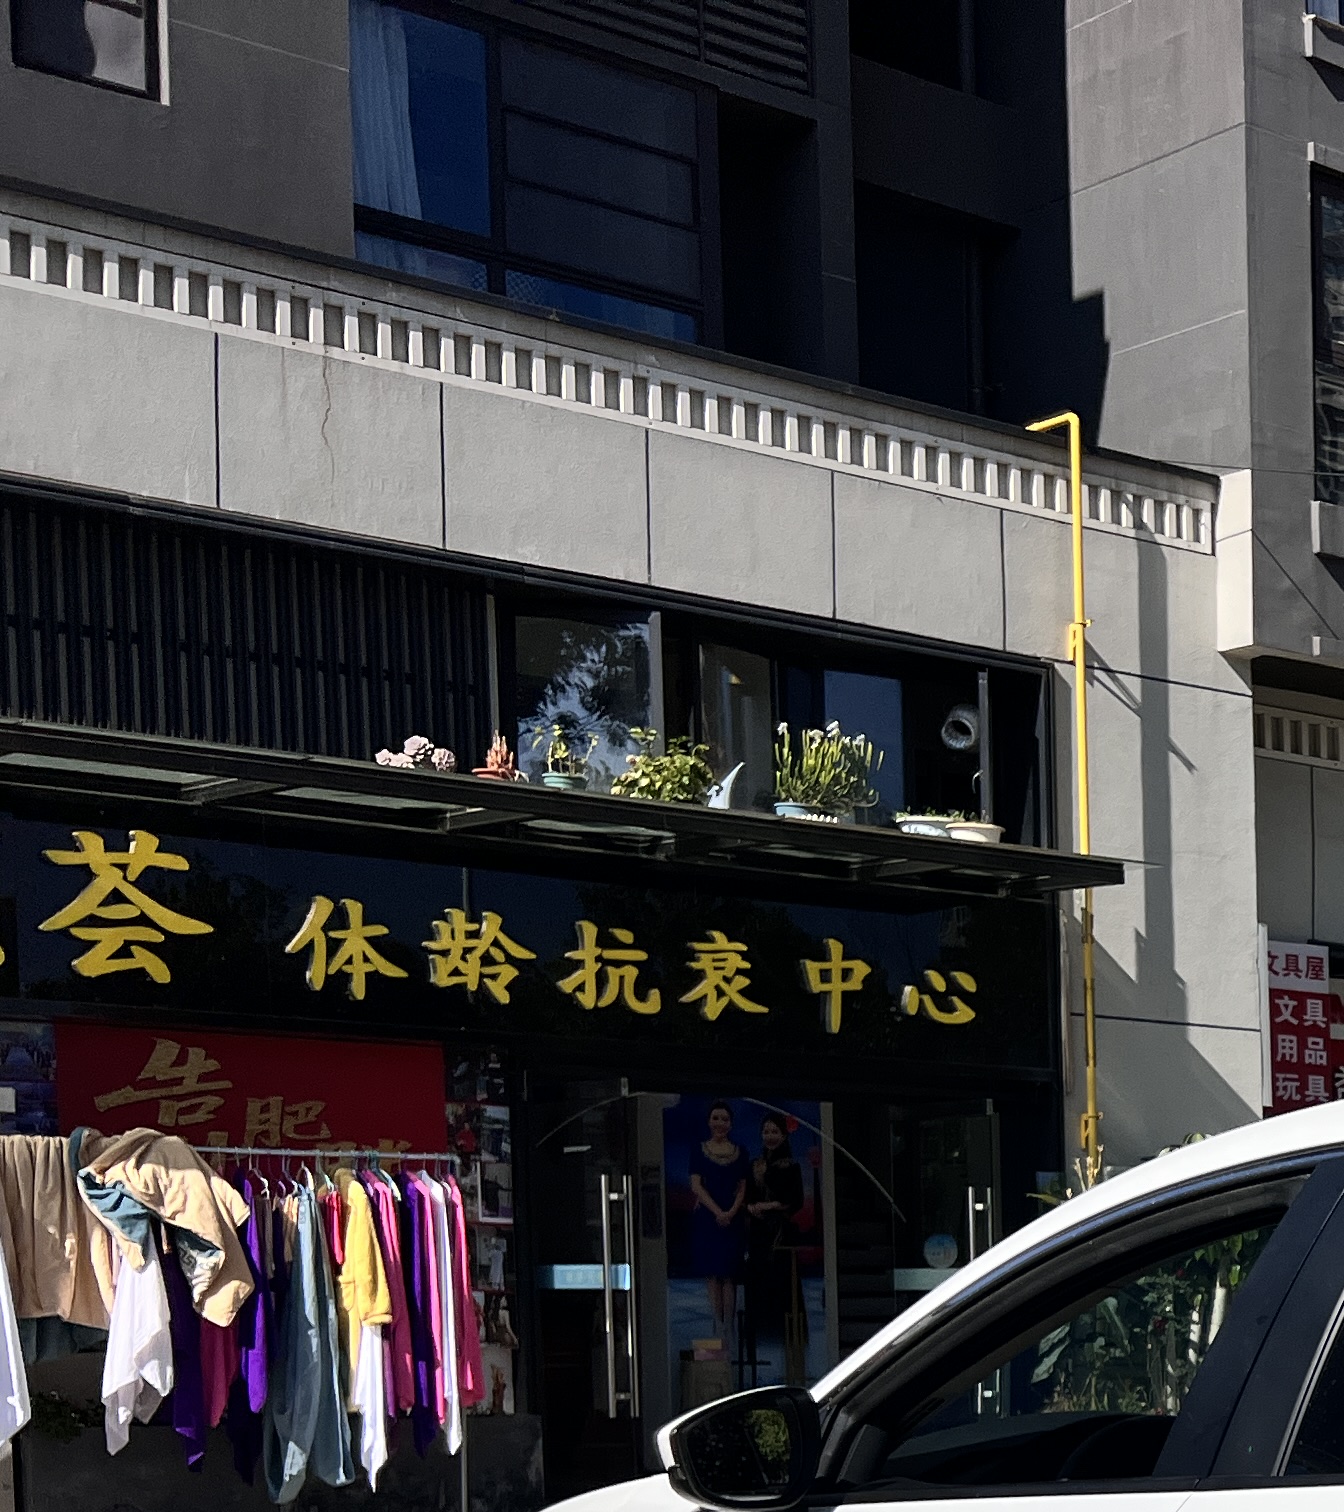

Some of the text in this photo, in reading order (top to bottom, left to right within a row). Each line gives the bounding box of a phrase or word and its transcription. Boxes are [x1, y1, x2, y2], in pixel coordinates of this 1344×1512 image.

[0, 831, 977, 1034] 荟 体龄抗衰中心
[1275, 996, 1328, 1029] 文具
[1277, 1034, 1328, 1066] 用品
[1275, 1073, 1330, 1102] 玩具
